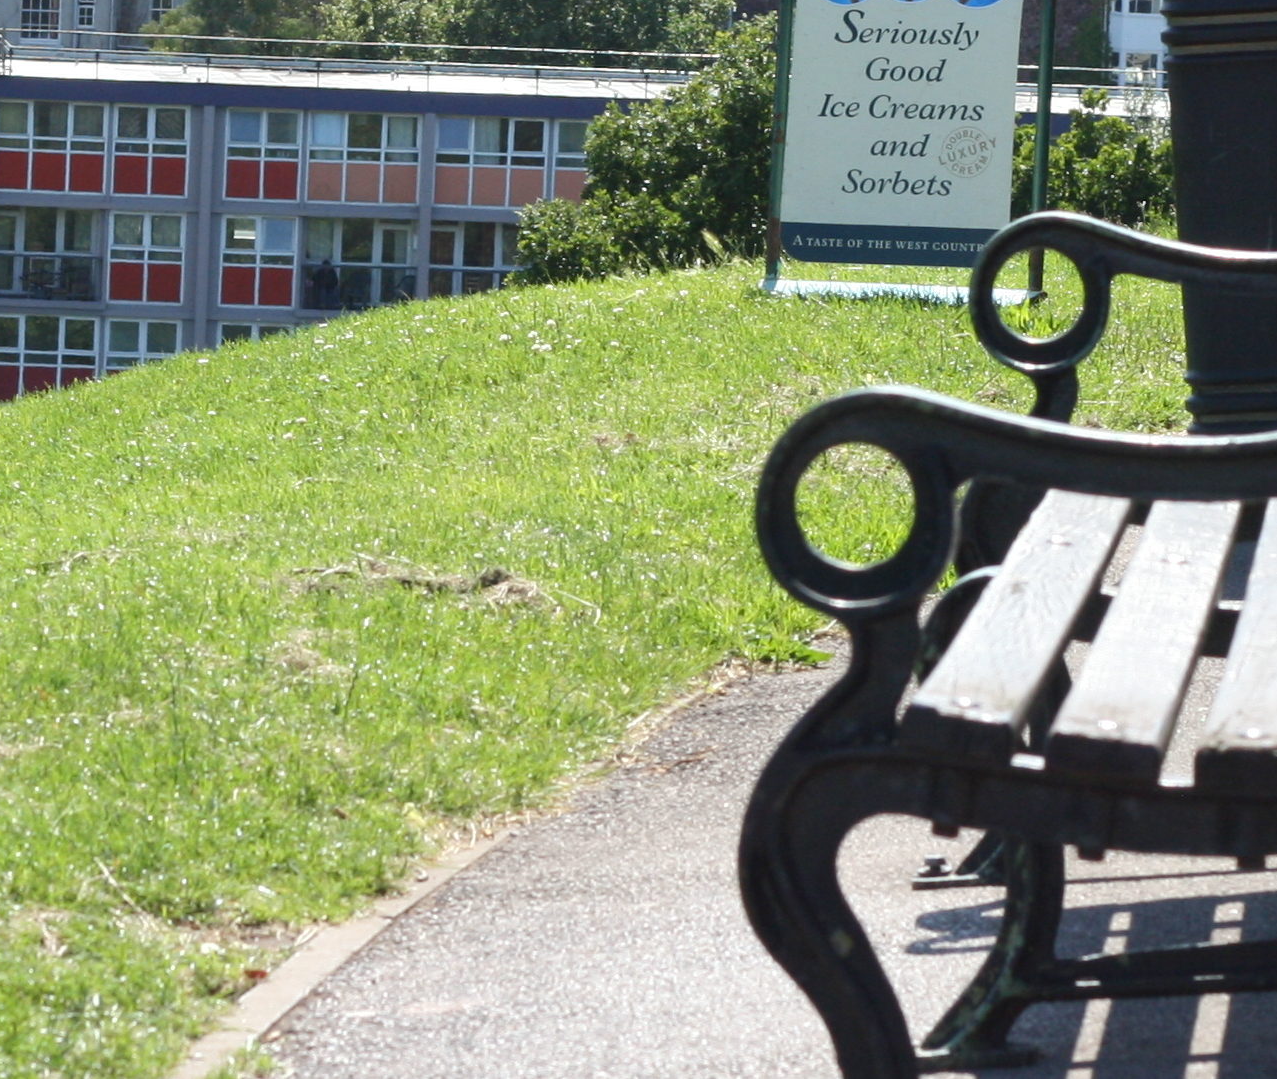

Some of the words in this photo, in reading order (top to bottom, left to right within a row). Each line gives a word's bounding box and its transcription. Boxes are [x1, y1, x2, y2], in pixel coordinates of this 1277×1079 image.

[835, 9, 980, 51] Seriously
[865, 56, 947, 83] Good
[818, 93, 860, 118] Ice
[868, 94, 985, 121] Creams
[870, 134, 931, 157] and
[938, 137, 996, 165] LUXURY
[945, 130, 982, 150] DOUBLE
[951, 155, 989, 175] CREAM
[841, 169, 953, 197] Sorbets
[793, 235, 803, 246] A
[806, 237, 843, 247] TASTE
[847, 239, 864, 248] OF
[867, 239, 892, 249] THE
[895, 240, 929, 250] WEST
[931, 242, 986, 252] COUNTR
